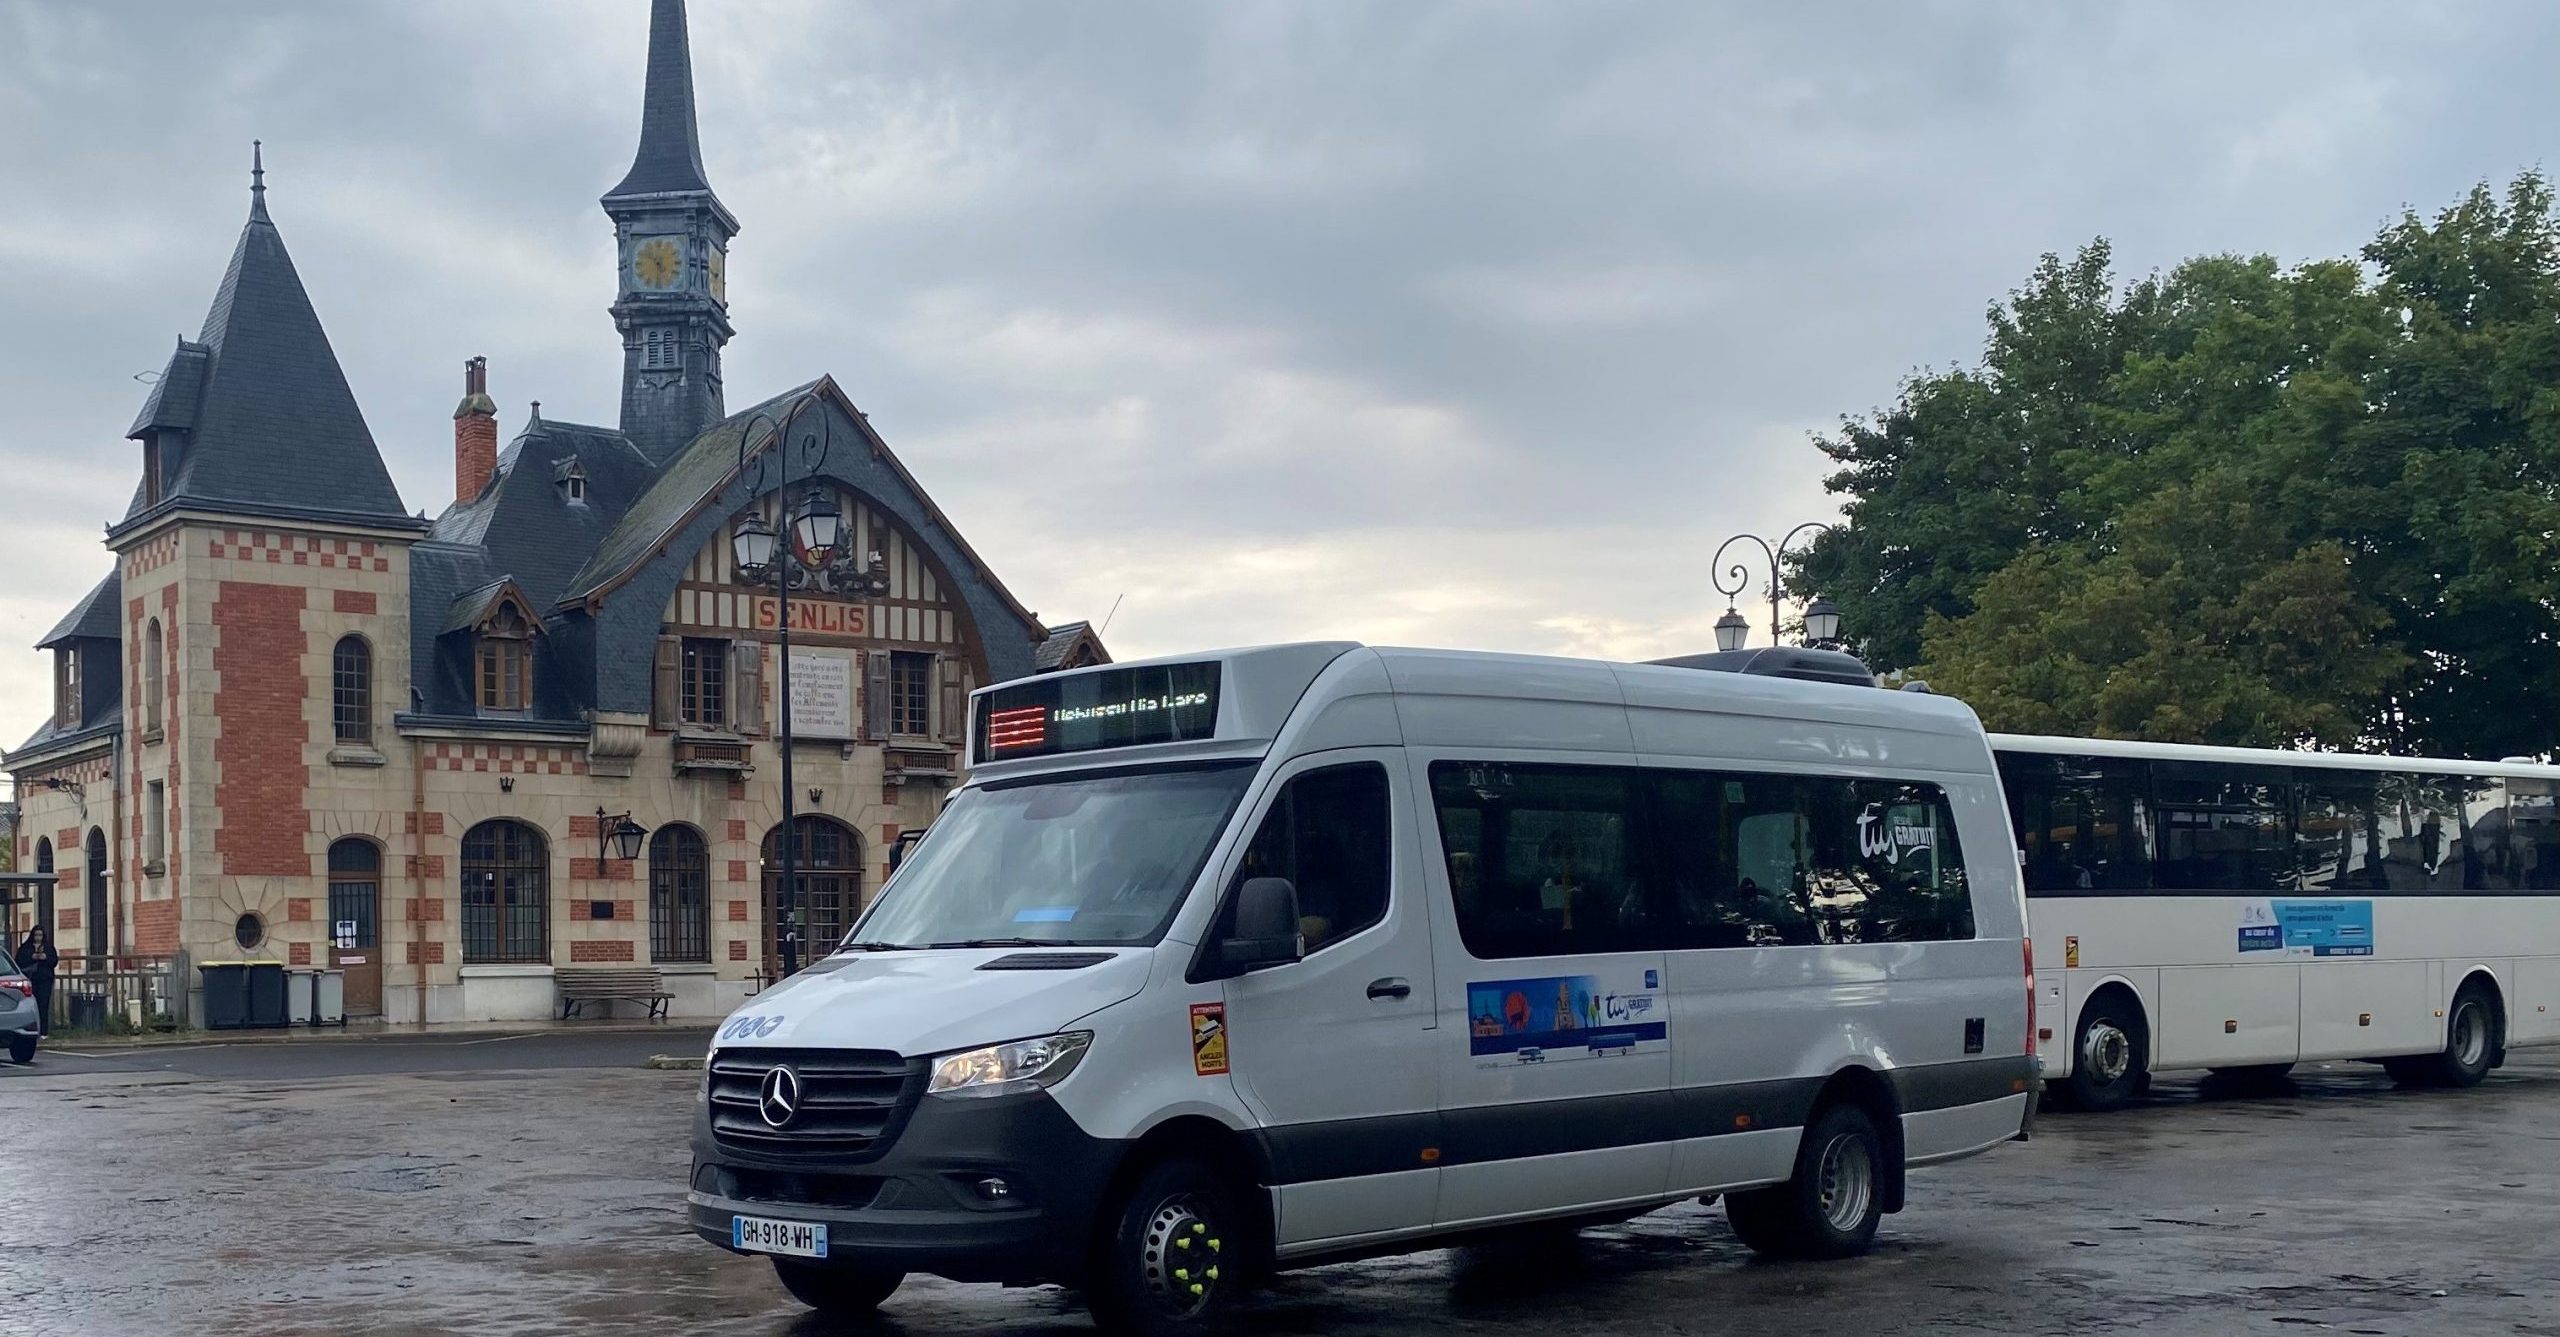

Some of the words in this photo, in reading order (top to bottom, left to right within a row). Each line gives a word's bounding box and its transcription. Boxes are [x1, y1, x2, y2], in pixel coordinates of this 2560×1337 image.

[760, 600, 864, 632] SENLIS
[1895, 826, 1935, 846] GRATUIT
[743, 1220, 812, 1250] GH-918-WH
